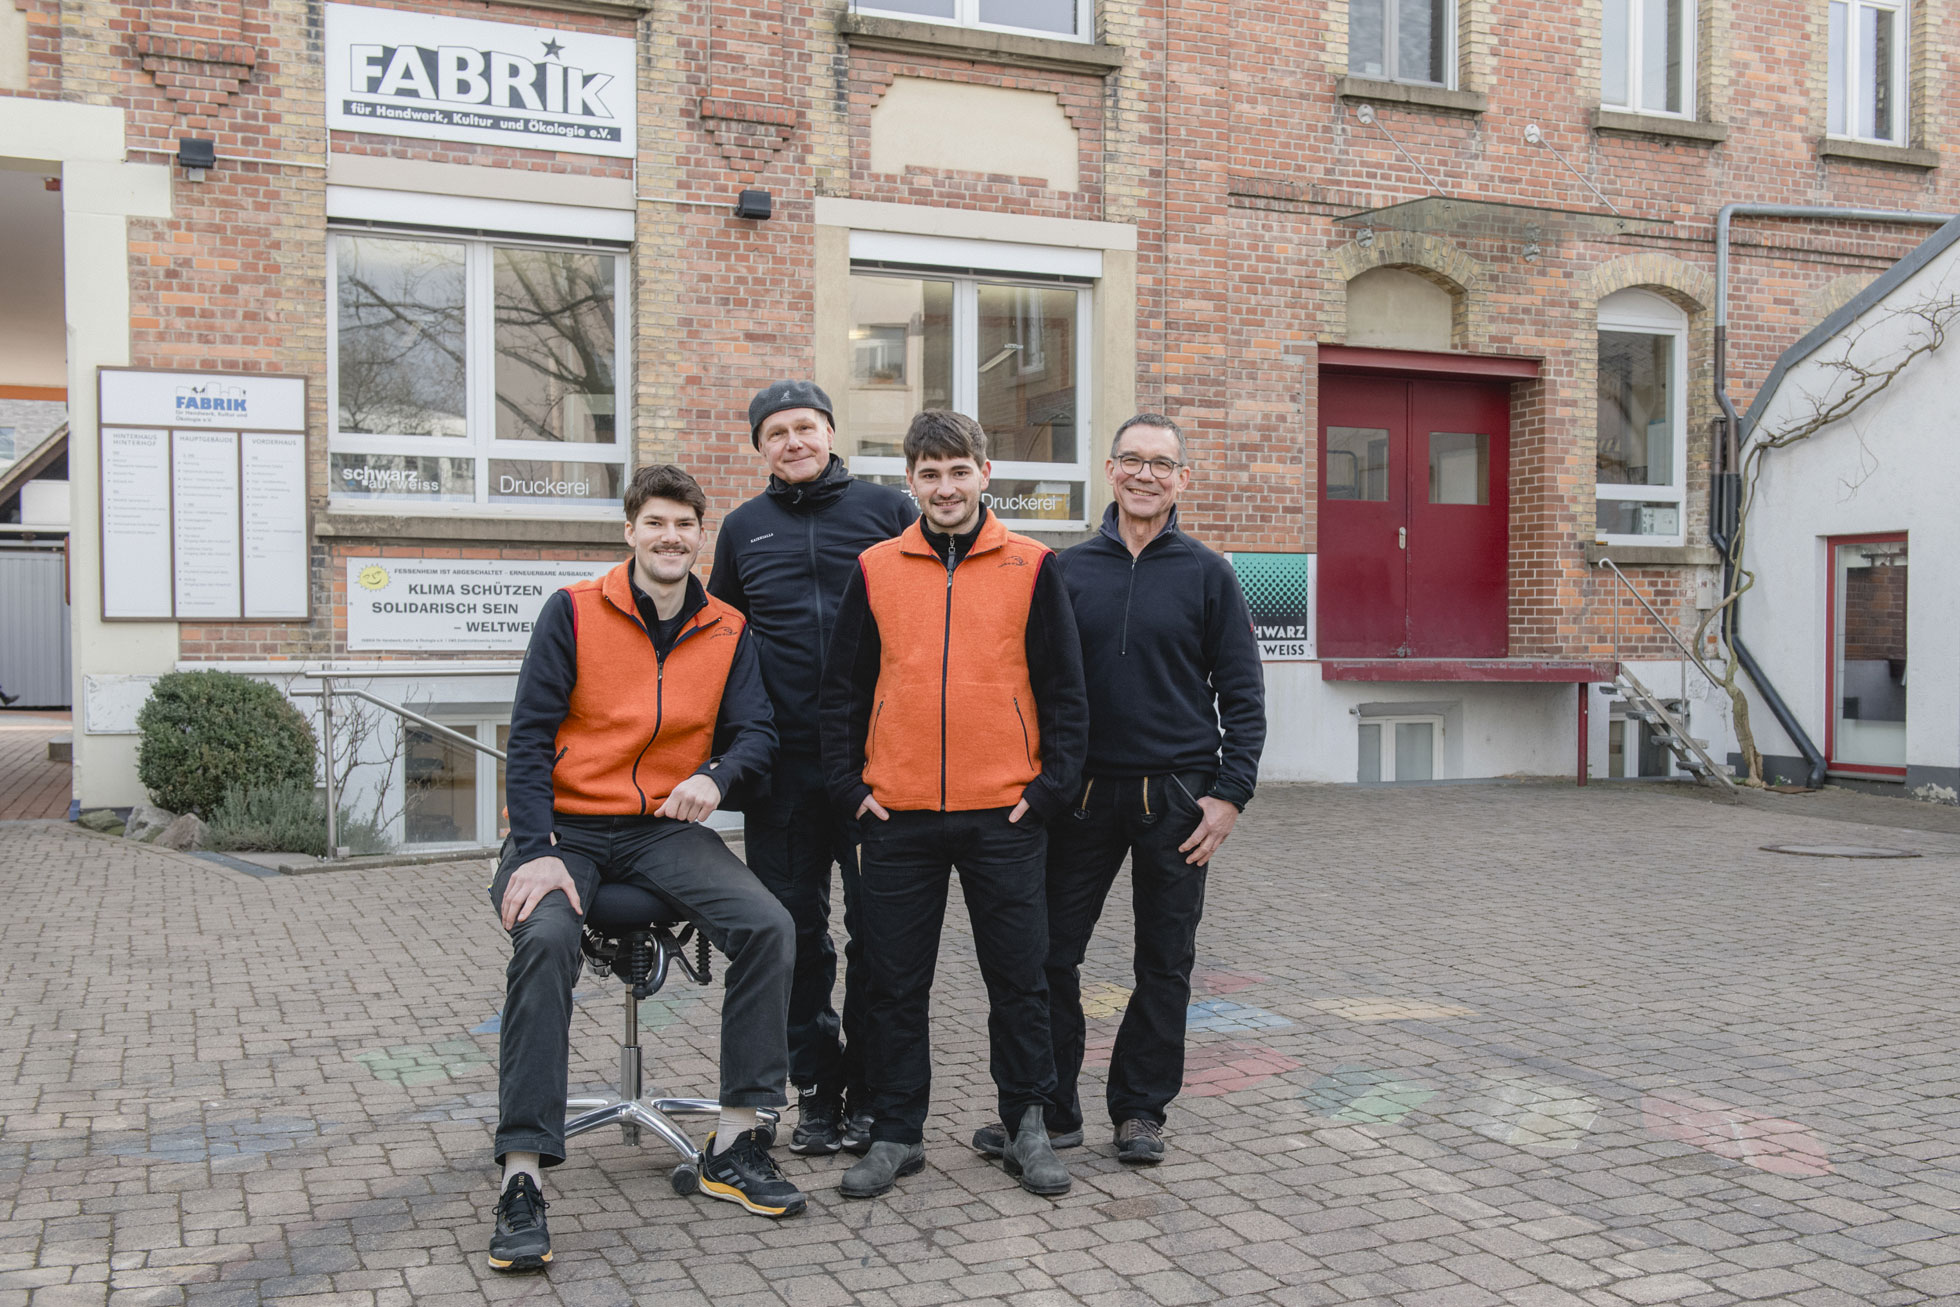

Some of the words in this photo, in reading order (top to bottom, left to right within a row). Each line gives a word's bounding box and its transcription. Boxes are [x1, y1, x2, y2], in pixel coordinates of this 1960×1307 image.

[350, 43, 614, 119] FABRIK
[350, 102, 371, 116] für
[376, 104, 448, 124] Handwerk,
[452, 112, 493, 127] Kultur
[500, 119, 523, 131] und
[528, 120, 585, 138] Ökologie
[589, 128, 611, 140] e.V.
[176, 396, 247, 411] FABRIK
[180, 435, 233, 443] HAUPTGEBÄUDE
[343, 466, 418, 482] schwarz
[397, 478, 439, 491] weiss
[500, 475, 590, 496] Druckerei
[981, 493, 1056, 510] Druckerei
[408, 584, 455, 596] KLIMA
[460, 582, 543, 596] SCHÜTZEN
[372, 602, 477, 614] SOLIDARISCH
[482, 603, 519, 614] SEIN
[466, 621, 535, 632] WELTWEI
[1254, 625, 1305, 639] HWARZ
[1263, 644, 1305, 656] WEISS
